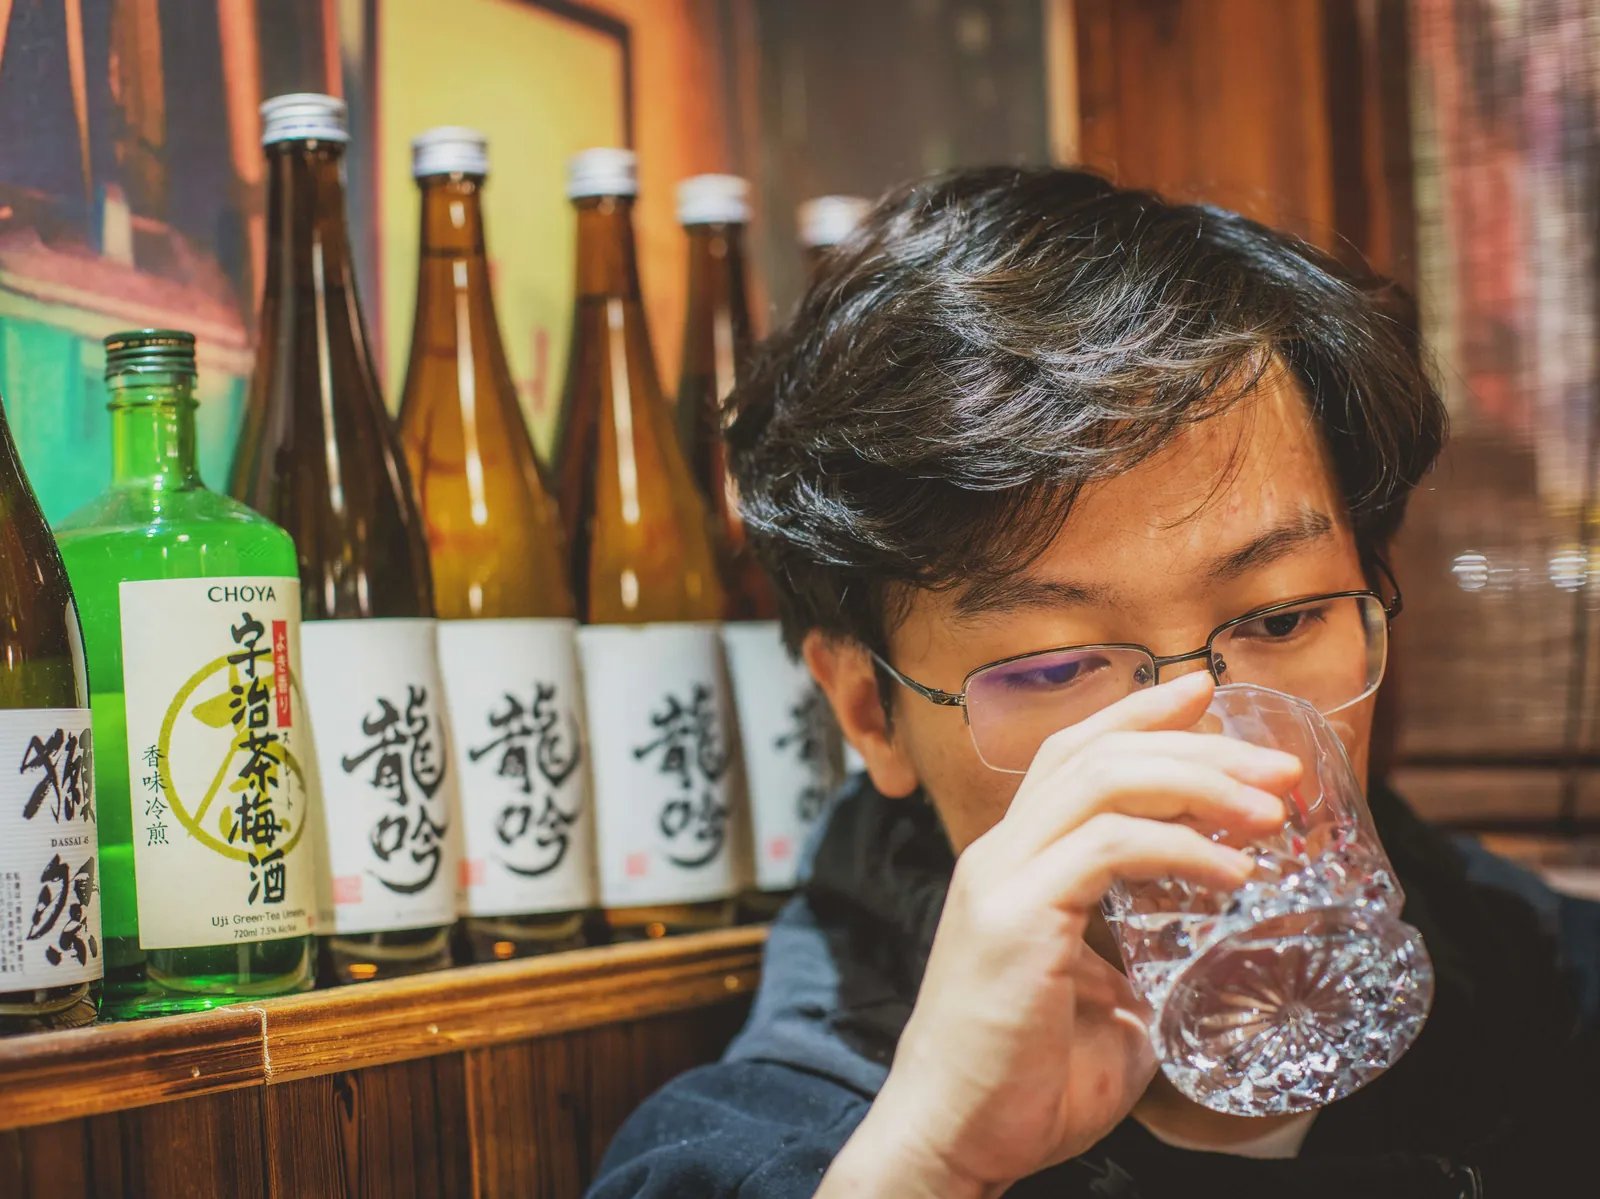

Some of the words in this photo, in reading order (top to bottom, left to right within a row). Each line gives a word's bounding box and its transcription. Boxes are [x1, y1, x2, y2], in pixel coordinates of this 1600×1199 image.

[208, 586, 276, 602] CHOYA
[227, 612, 286, 905] 宇治茶梅酒
[142, 744, 169, 847] 香味冷煎
[51, 836, 81, 848] DASSAI
[211, 915, 229, 927] Uji
[234, 928, 258, 939] 720ml
